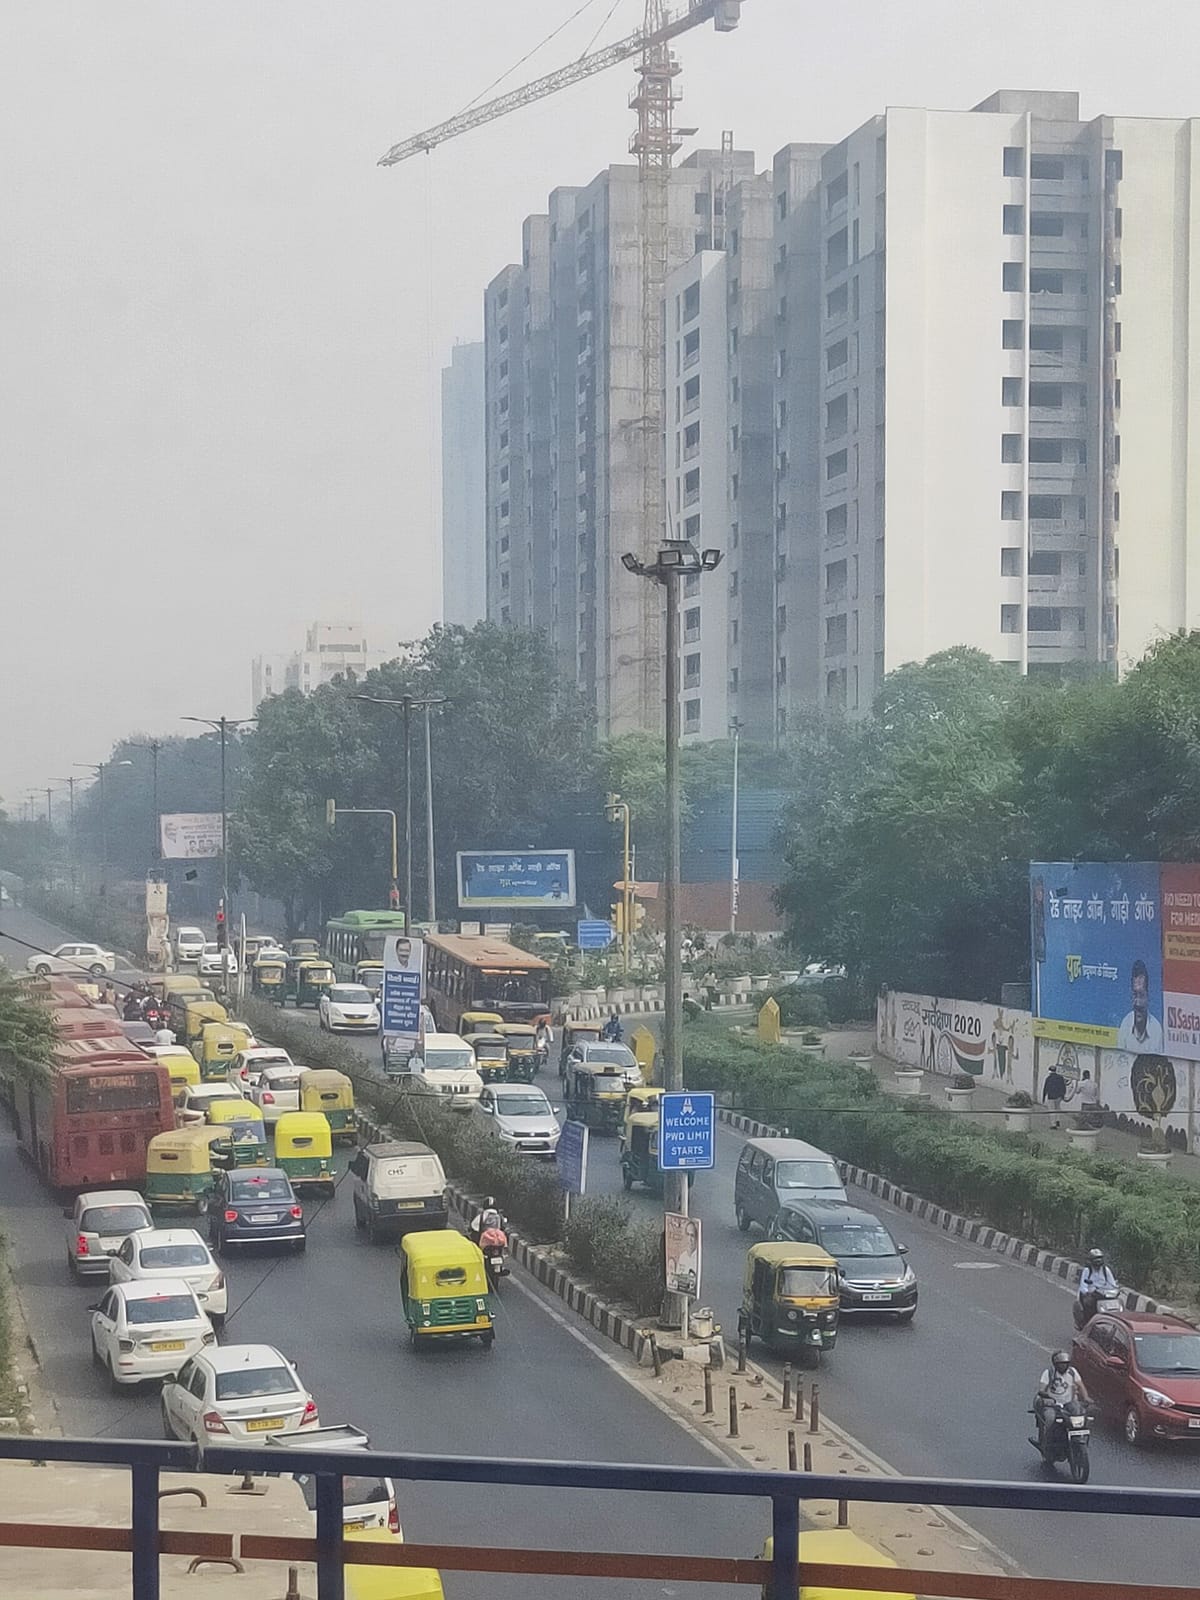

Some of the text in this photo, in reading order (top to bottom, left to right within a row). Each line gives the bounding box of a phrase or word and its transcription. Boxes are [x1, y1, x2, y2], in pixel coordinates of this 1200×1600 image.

[1049, 890, 1060, 918] रेड
[1062, 899, 1084, 924] लाइट
[1110, 892, 1130, 925] गाड़ी
[1134, 892, 1155, 922] ऑफ
[954, 1014, 981, 1037] 2020
[665, 1116, 710, 1127] WELCOME
[665, 1131, 710, 1142] PWD LIMIT
[671, 1146, 704, 1156] STARTS
